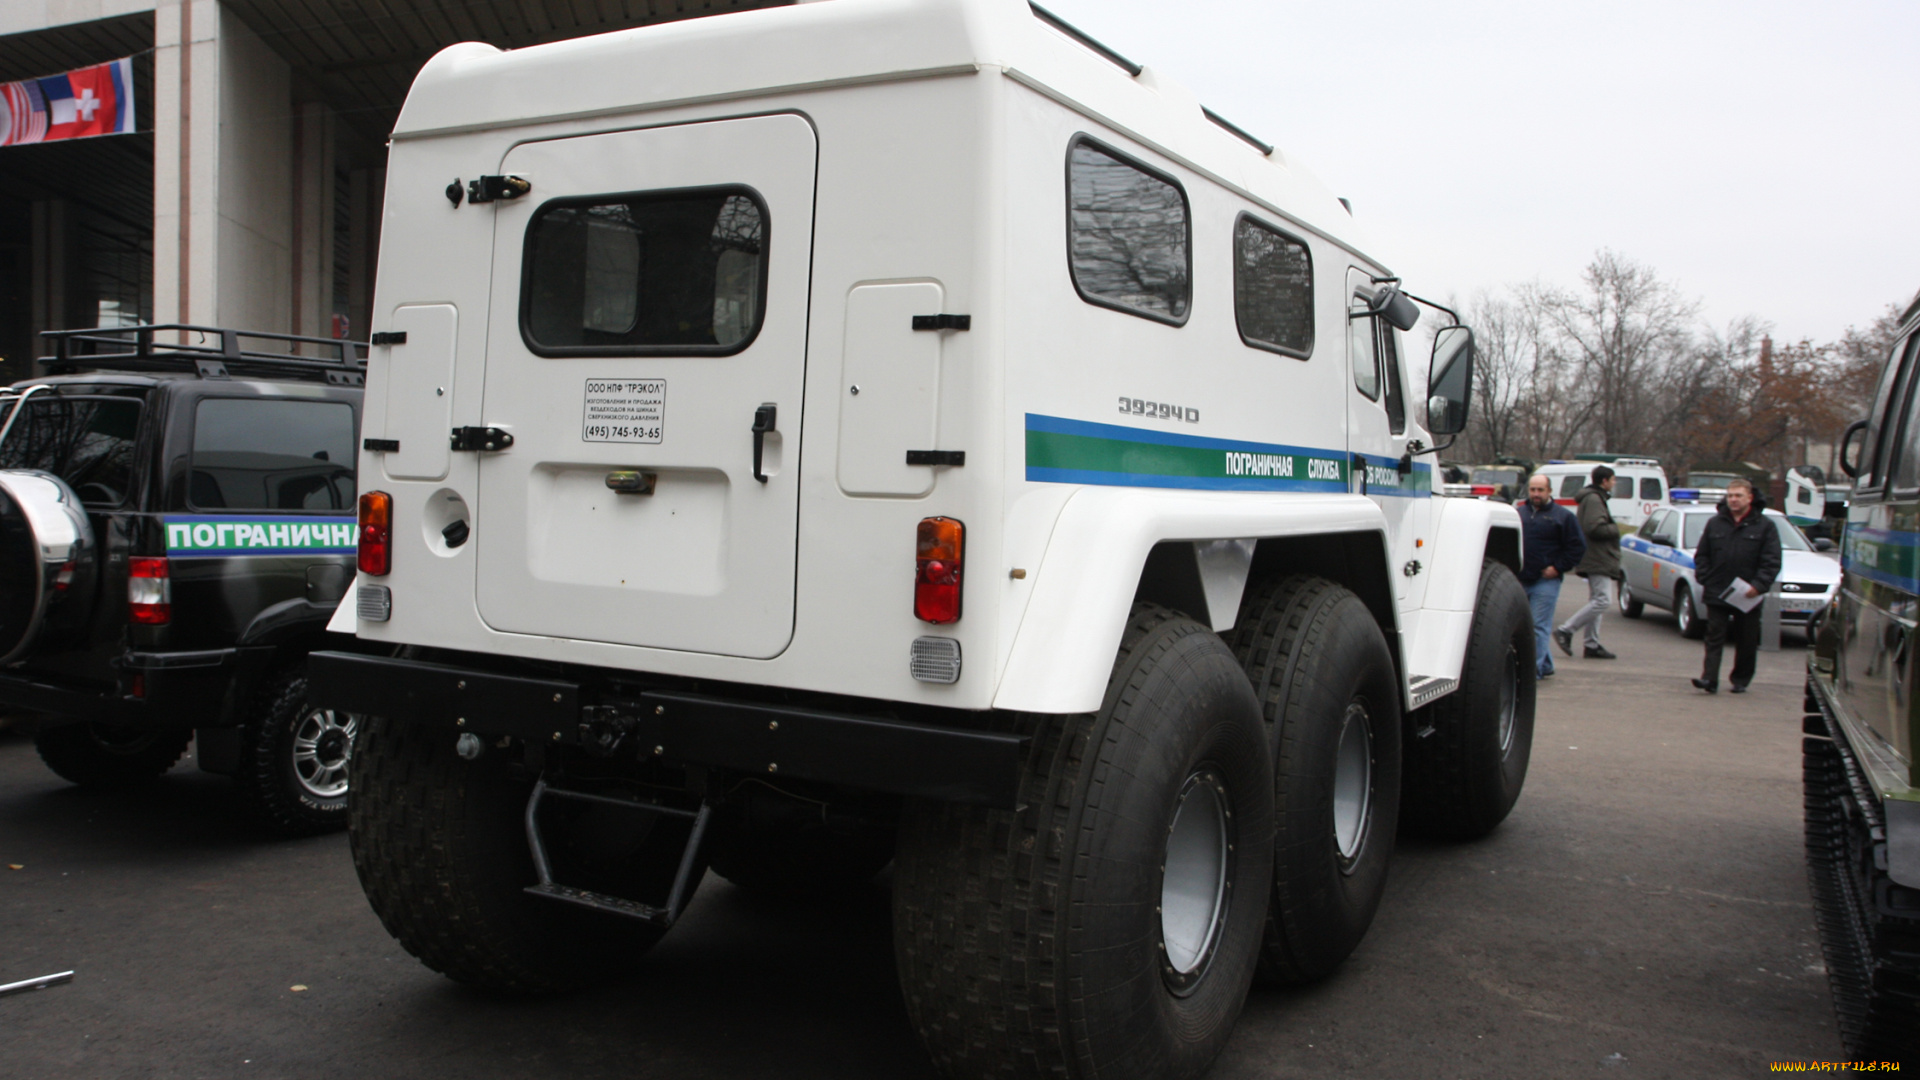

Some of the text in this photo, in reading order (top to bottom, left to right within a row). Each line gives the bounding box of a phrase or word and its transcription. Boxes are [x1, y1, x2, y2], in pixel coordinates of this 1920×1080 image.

[587, 383, 664, 394] ООО НПФ "ТРЭКОЛ"
[585, 425, 660, 439] (495) 745-93-65
[1225, 452, 1293, 477] ПОГРАНИЧНАЯ
[1308, 458, 1340, 480] СЛУЖБА
